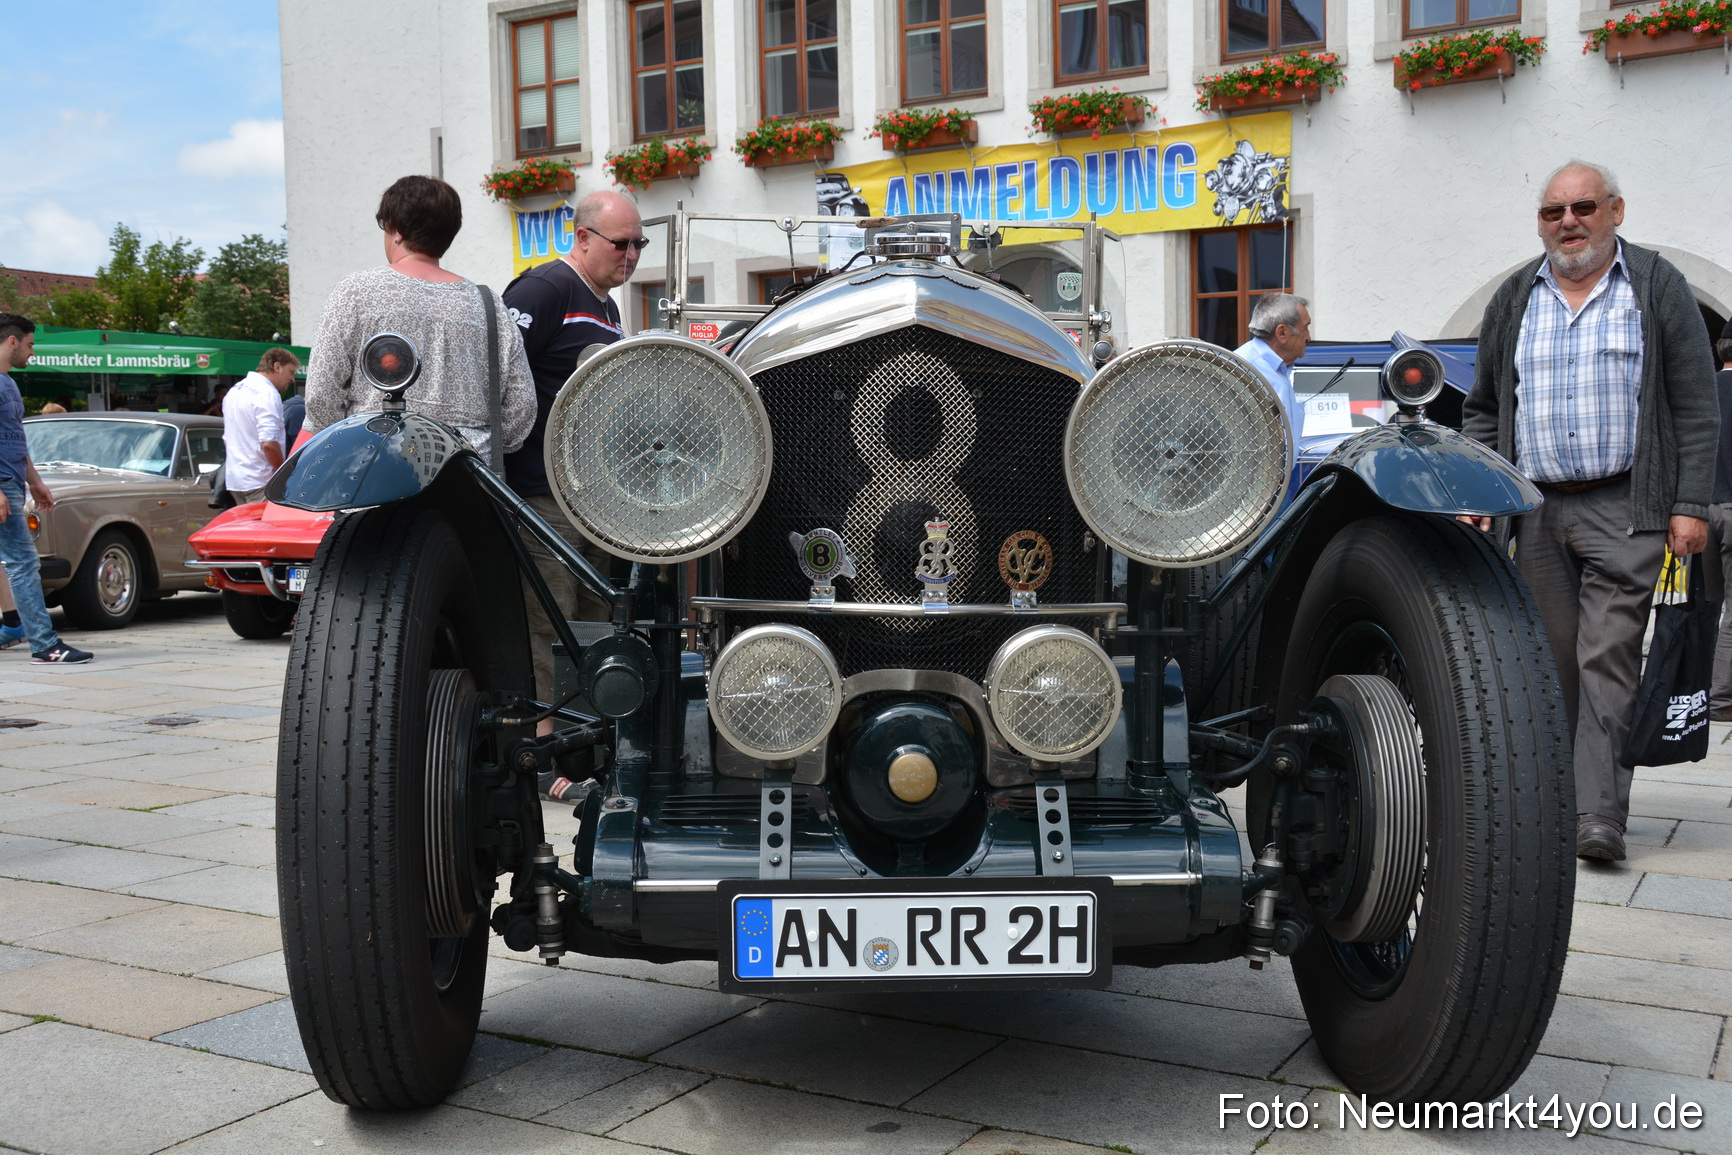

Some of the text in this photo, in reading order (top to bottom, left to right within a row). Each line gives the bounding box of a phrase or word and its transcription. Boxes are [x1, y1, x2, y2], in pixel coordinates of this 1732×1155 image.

[884, 142, 1198, 221] ANMELDUNG
[516, 207, 575, 259] WC
[26, 353, 190, 368] eumarkter Lammsbräu
[1317, 401, 1338, 411] 610
[804, 529, 836, 541] BENTLEY
[775, 905, 1088, 967] AN RR 2H
[748, 946, 762, 964] D
